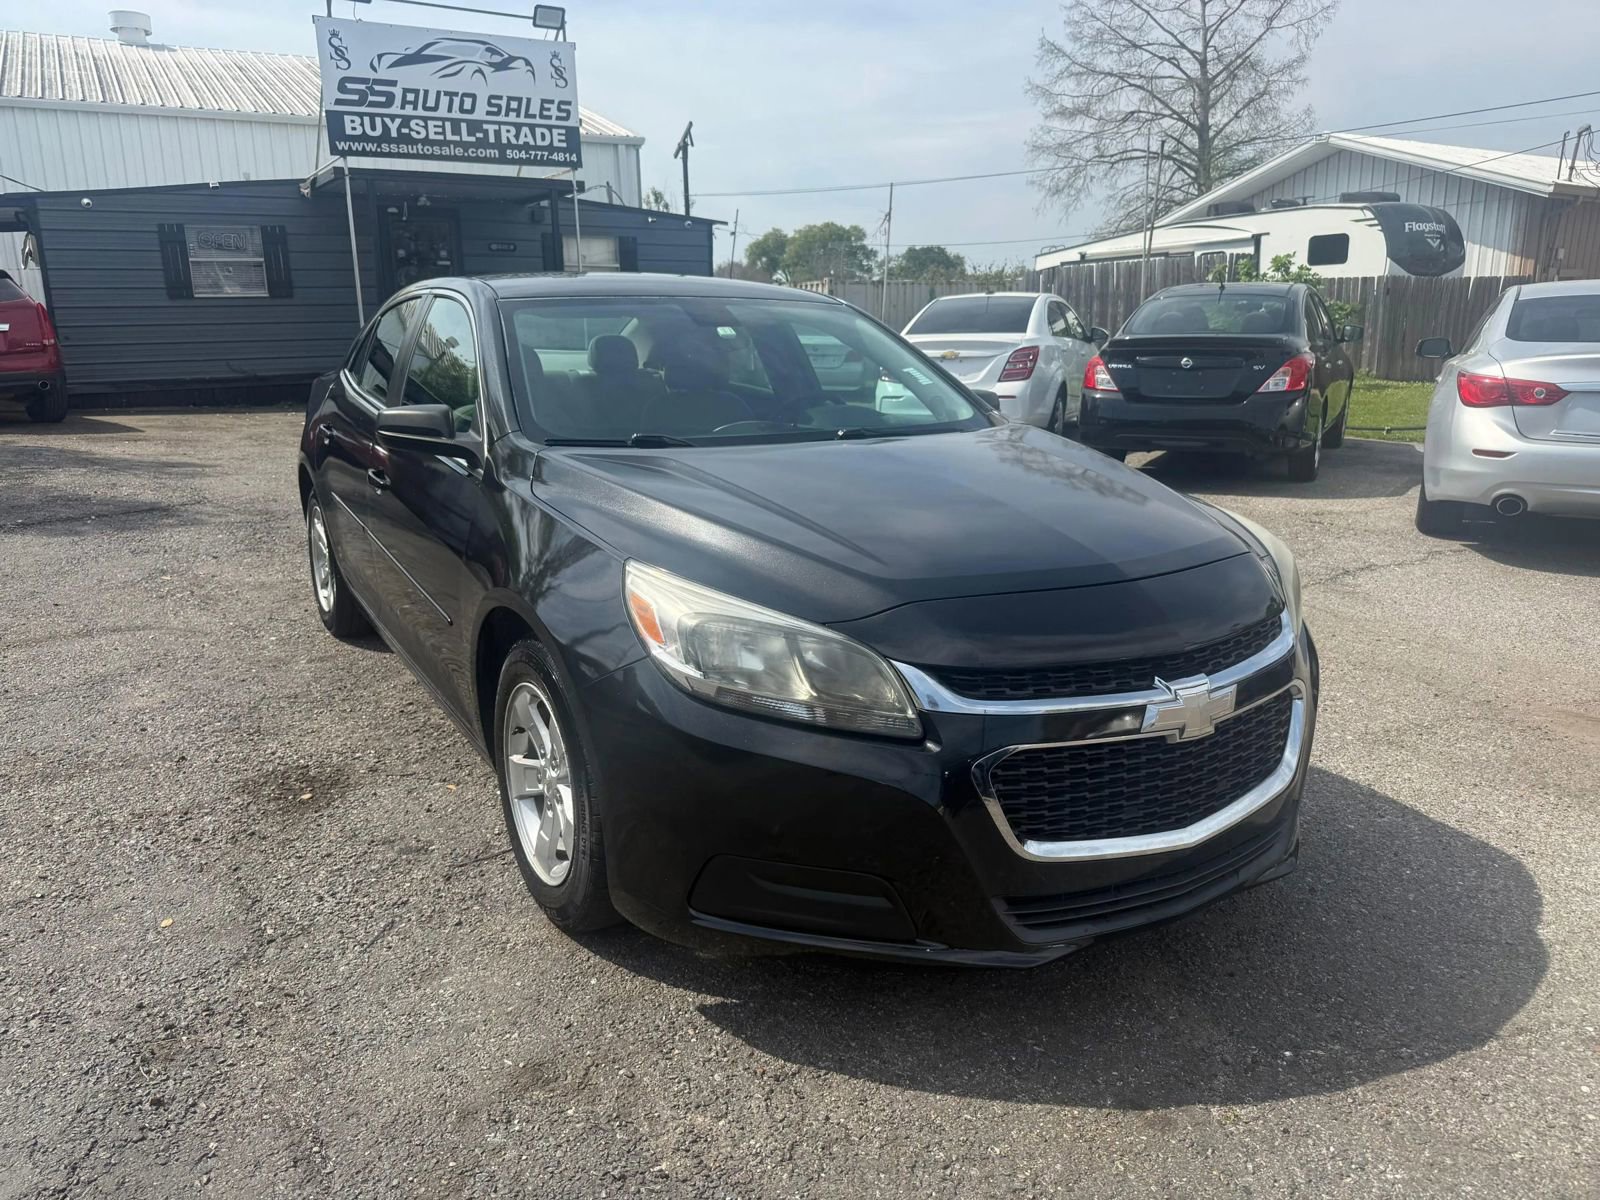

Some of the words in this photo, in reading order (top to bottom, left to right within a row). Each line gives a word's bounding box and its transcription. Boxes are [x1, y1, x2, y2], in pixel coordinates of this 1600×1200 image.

[333, 76, 398, 109] SS
[400, 88, 477, 115] AUTO
[485, 94, 572, 122] SALES
[344, 115, 567, 148] BUY-SELL-TRADE
[335, 141, 499, 158] www.ssautosale.com
[506, 149, 578, 162] 504-777-4814
[199, 232, 246, 250] OPEN
